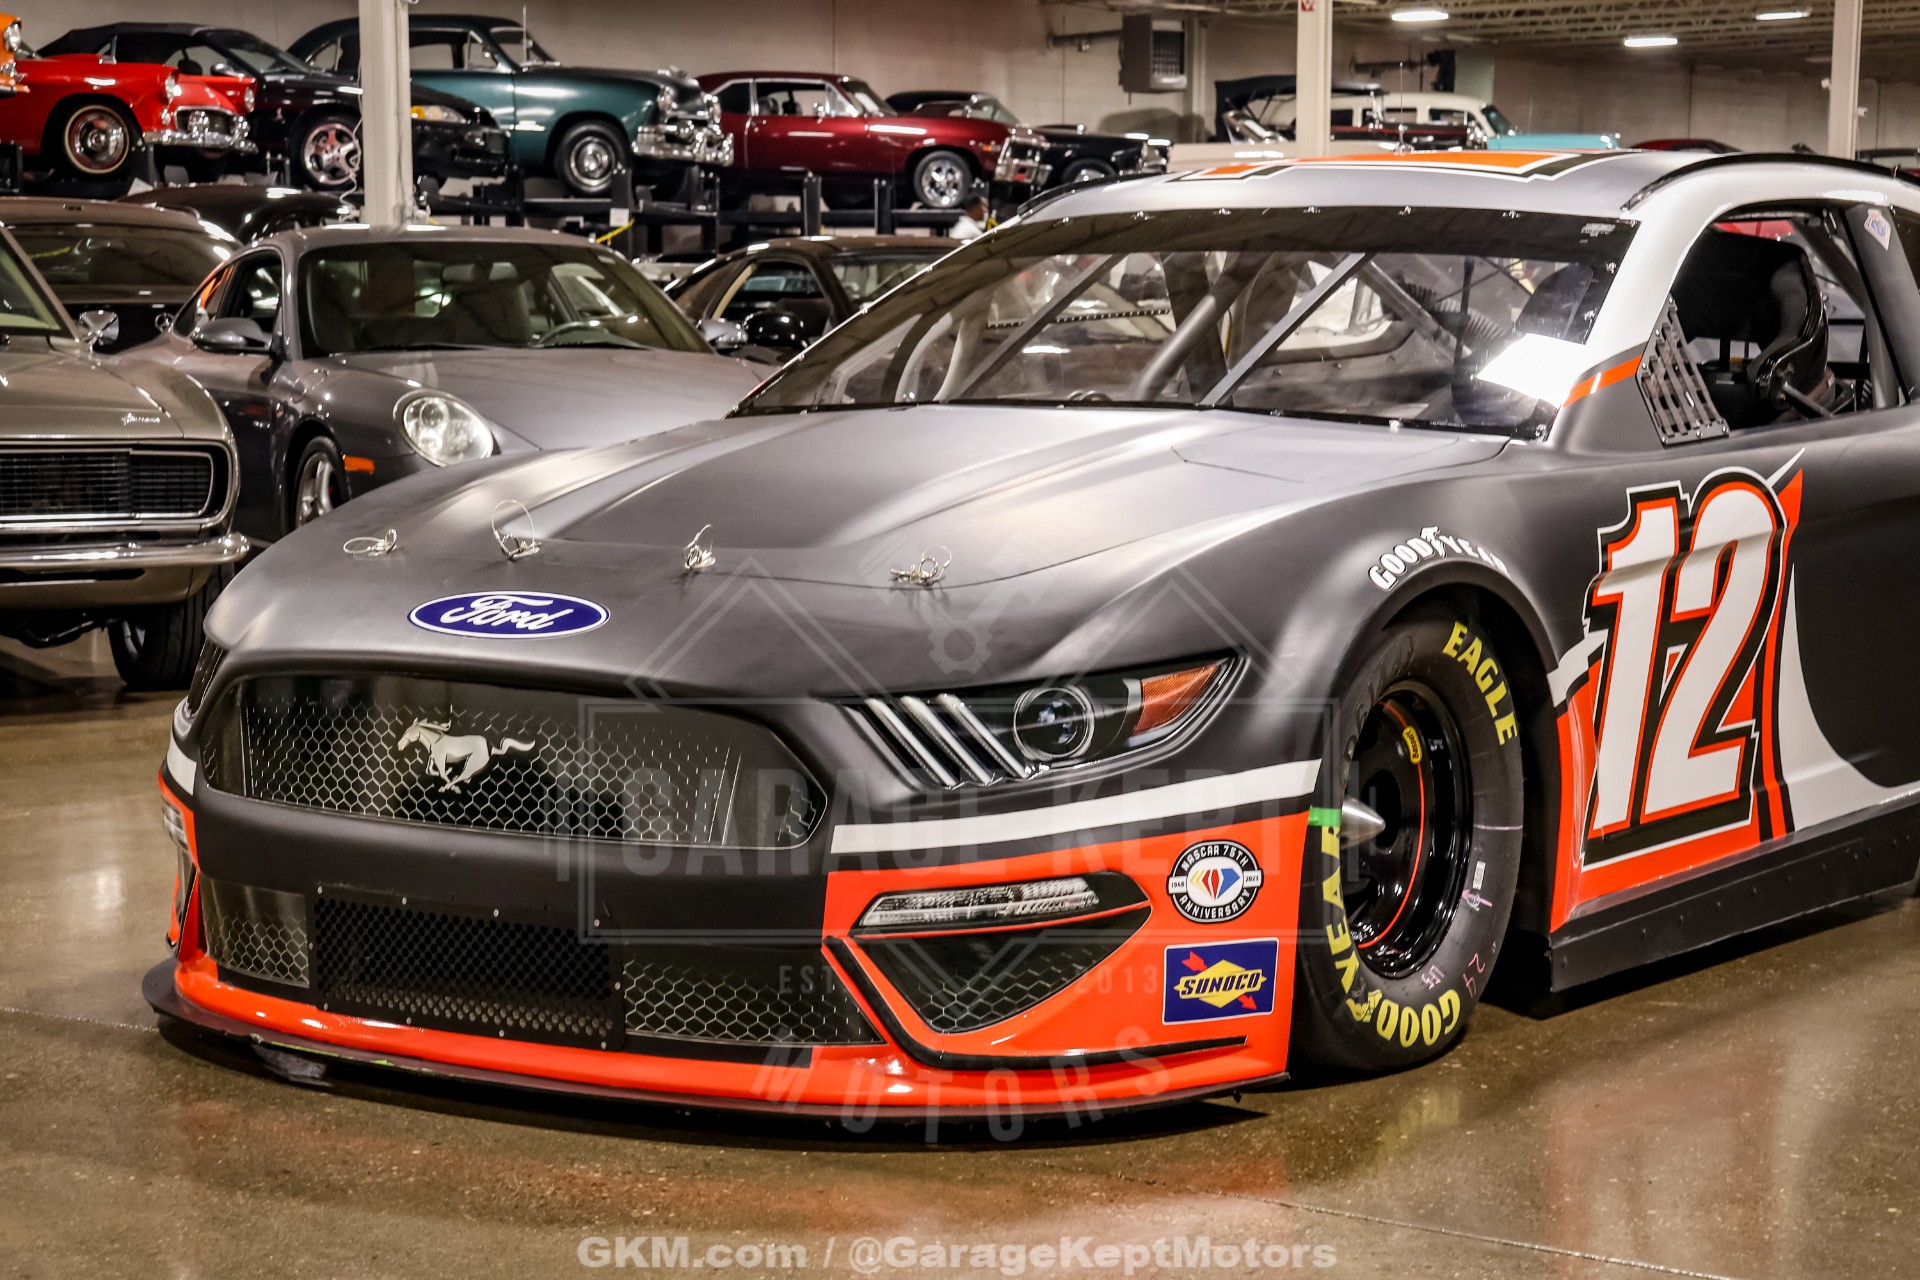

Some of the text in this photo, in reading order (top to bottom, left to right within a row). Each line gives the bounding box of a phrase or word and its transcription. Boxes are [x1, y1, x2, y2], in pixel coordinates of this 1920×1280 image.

[440, 595, 574, 630] Ford
[1584, 472, 1784, 850] 12
[1443, 621, 1518, 746] EAGLE
[1181, 844, 1249, 872] NASCAR 75TH
[1179, 888, 1250, 918] ANNIVERSARY
[1181, 973, 1261, 995] SUNOCO
